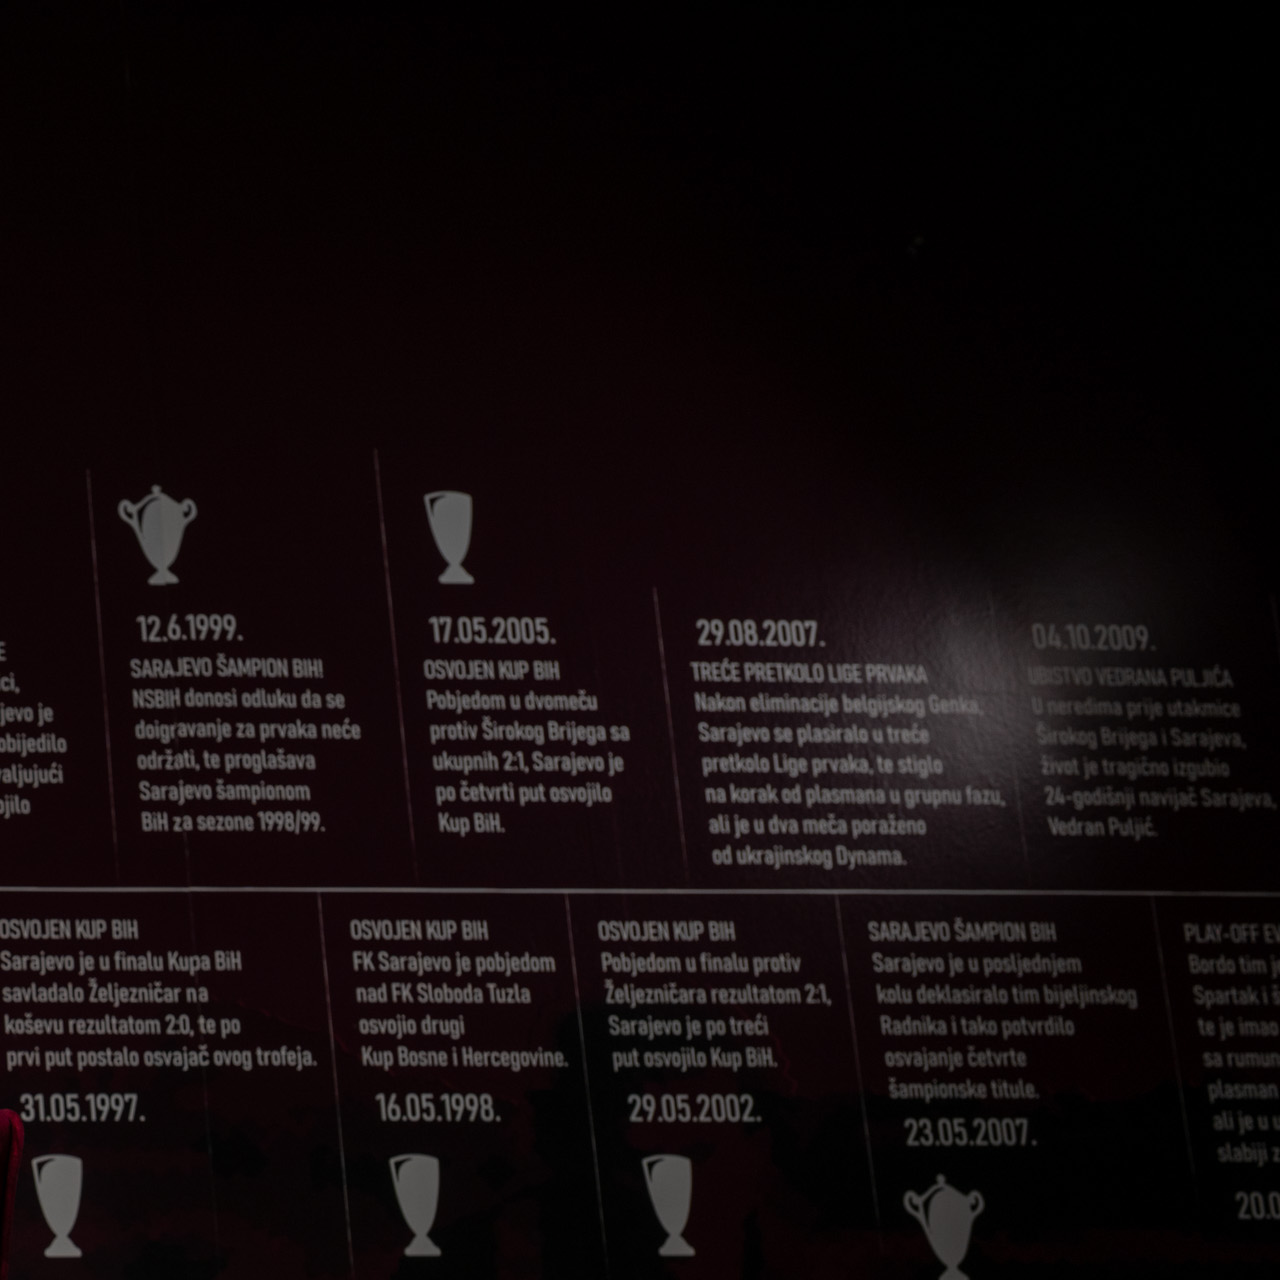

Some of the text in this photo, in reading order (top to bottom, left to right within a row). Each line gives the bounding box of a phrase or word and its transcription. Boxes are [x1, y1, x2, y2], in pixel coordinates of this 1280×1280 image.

[136, 613, 244, 643] 12.6.1999.
[428, 616, 557, 645] 17.05.2005.
[695, 618, 826, 648] 29.08.2007.
[129, 652, 324, 679] SARAJEVO ŠAMPION BIH!
[423, 658, 561, 681] OSVOJEN KUP BIH
[827, 662, 863, 684] LIGE
[864, 662, 929, 684] PRVAKA
[429, 716, 631, 746] protiv Širokog Brijega sa
[140, 809, 326, 835] BiH za sezone 1998/99.
[437, 812, 506, 838] Kup BiH.
[711, 844, 733, 866] od
[75, 918, 107, 940] KUP
[111, 918, 139, 940] BIH
[349, 918, 489, 941] OSVOJEN KUP BIH
[597, 920, 736, 942] OSVOJEN KUP BIH
[867, 916, 1058, 943] SARAJEVO ŠAMPION BIH
[879, 1014, 1076, 1040] Radnika i tako potvrdilo
[361, 1045, 569, 1073] Kup Bosne i Hercegovine.
[19, 1093, 147, 1124] 31.05.1997.
[375, 1092, 502, 1123] 16.05.1998.
[627, 1093, 762, 1123] 29.05.2002.
[903, 1117, 1038, 1147] 23.05.2007.
